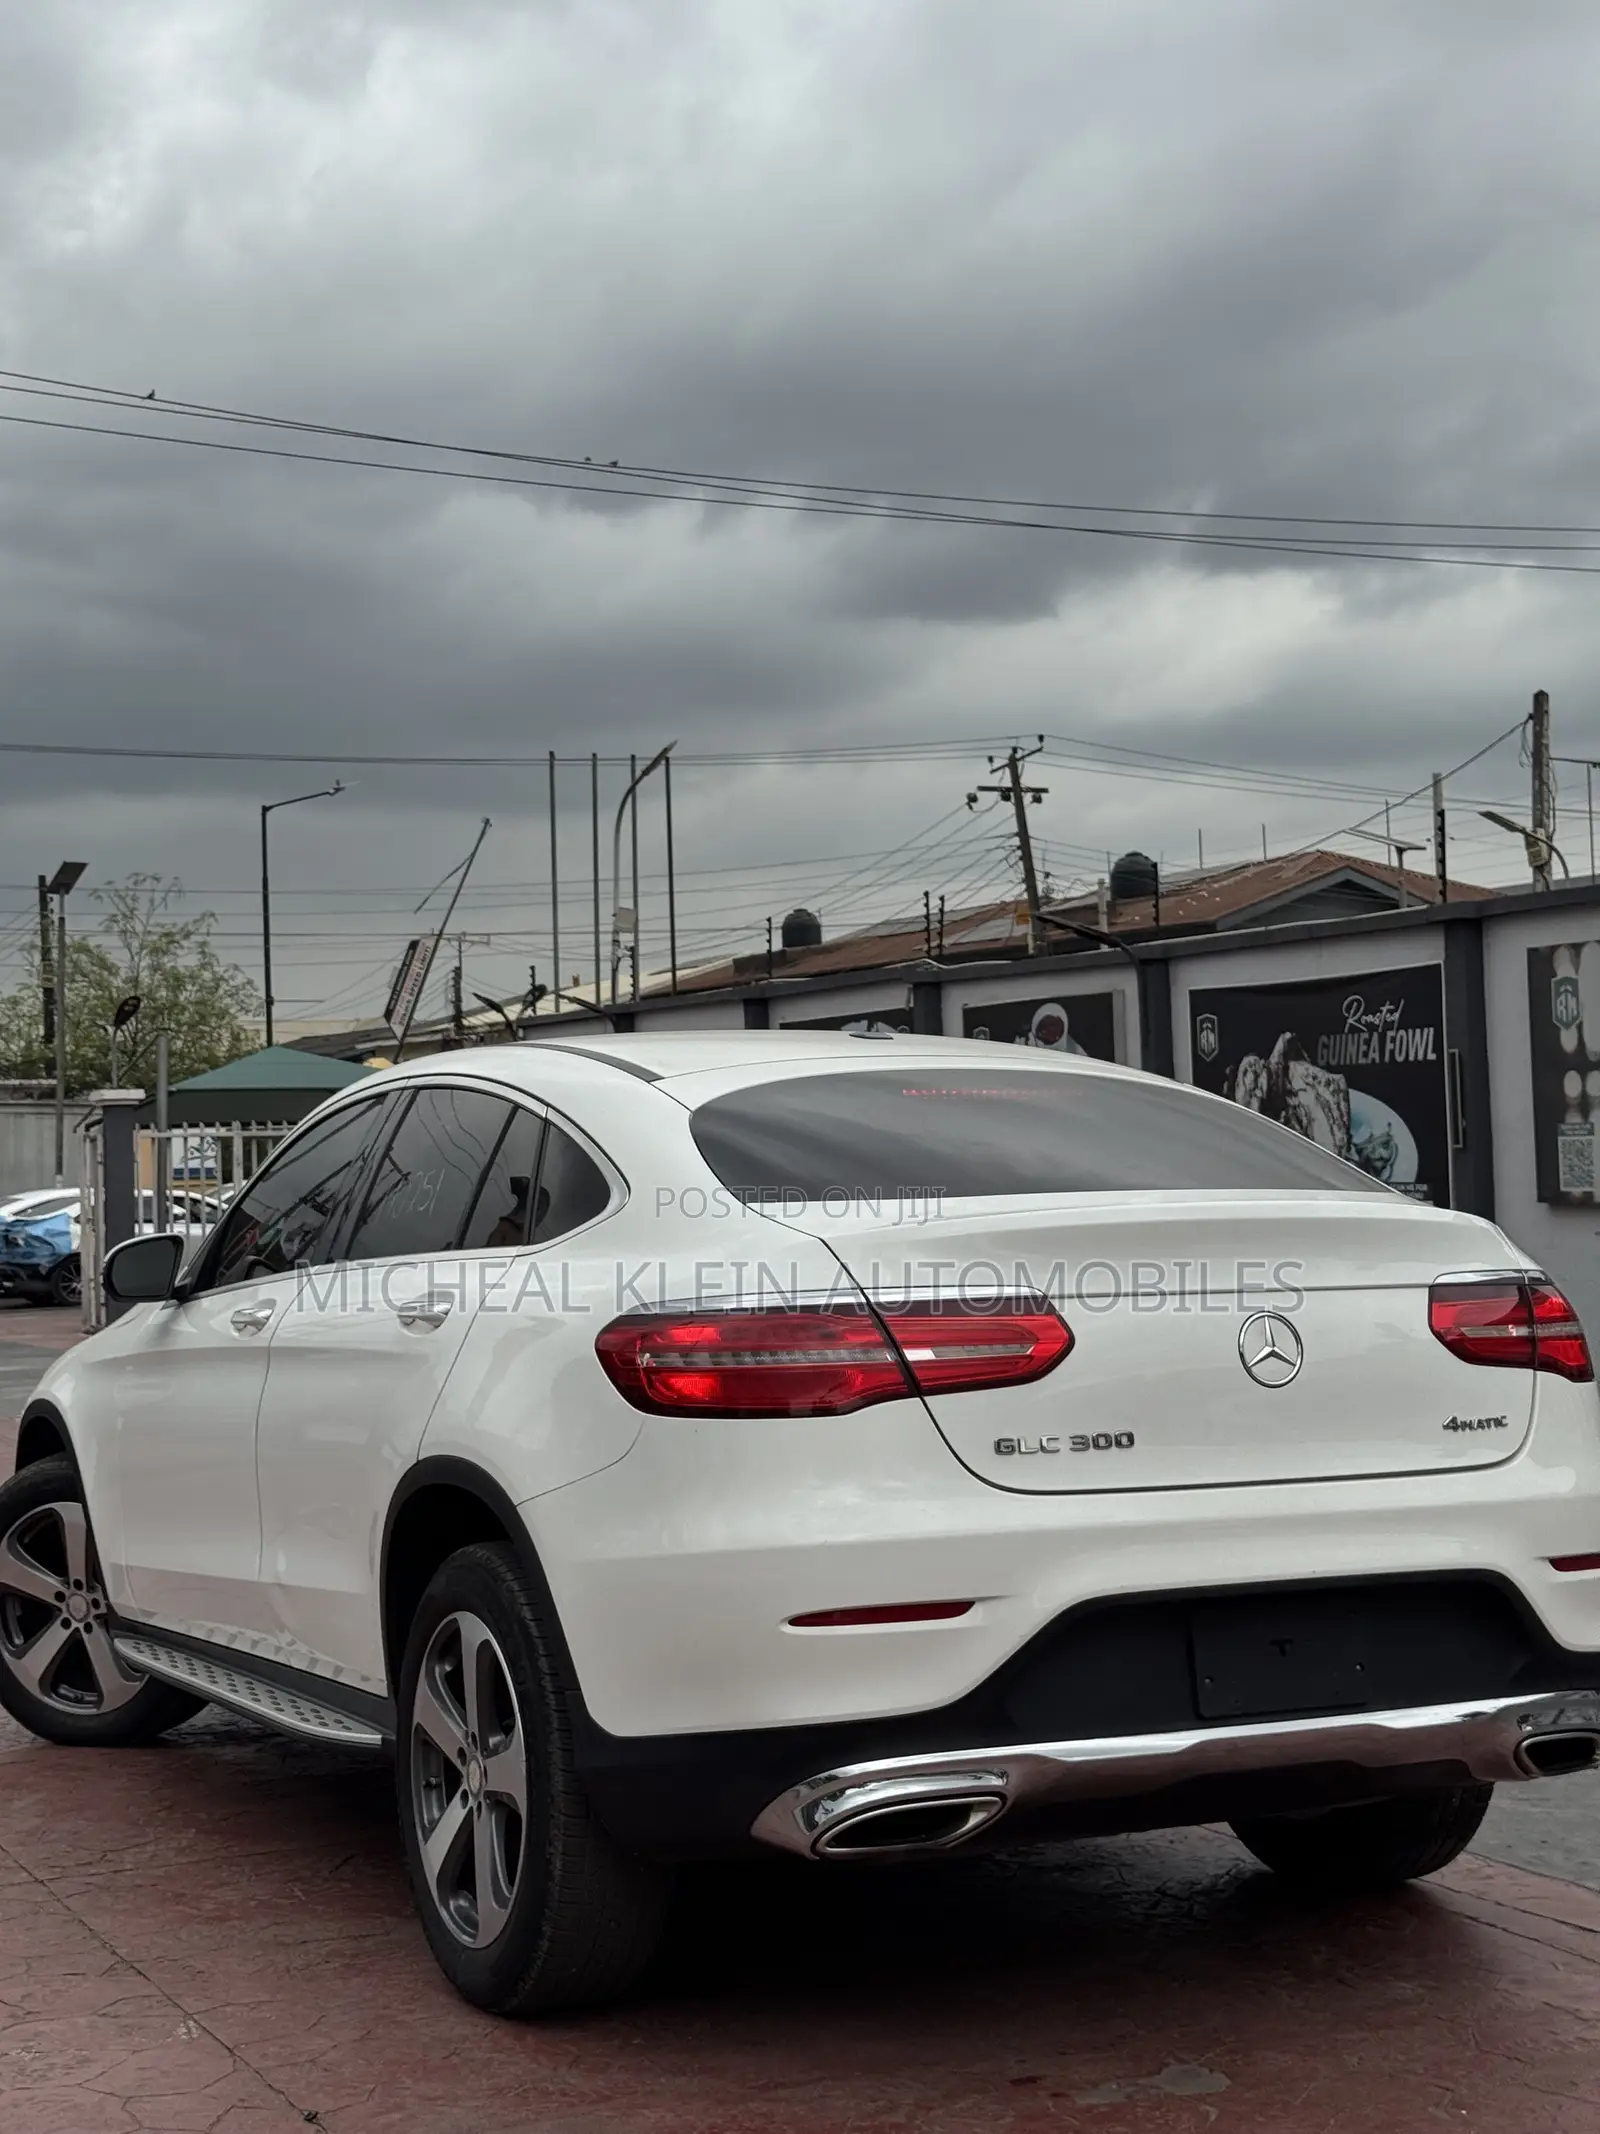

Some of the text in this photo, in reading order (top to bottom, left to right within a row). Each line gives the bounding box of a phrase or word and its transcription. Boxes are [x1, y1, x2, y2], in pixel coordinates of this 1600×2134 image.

[1342, 995, 1405, 1035] Roasted
[1317, 1027, 1437, 1066] GUINEA FOWL
[994, 1430, 1135, 1455] GLC 300
